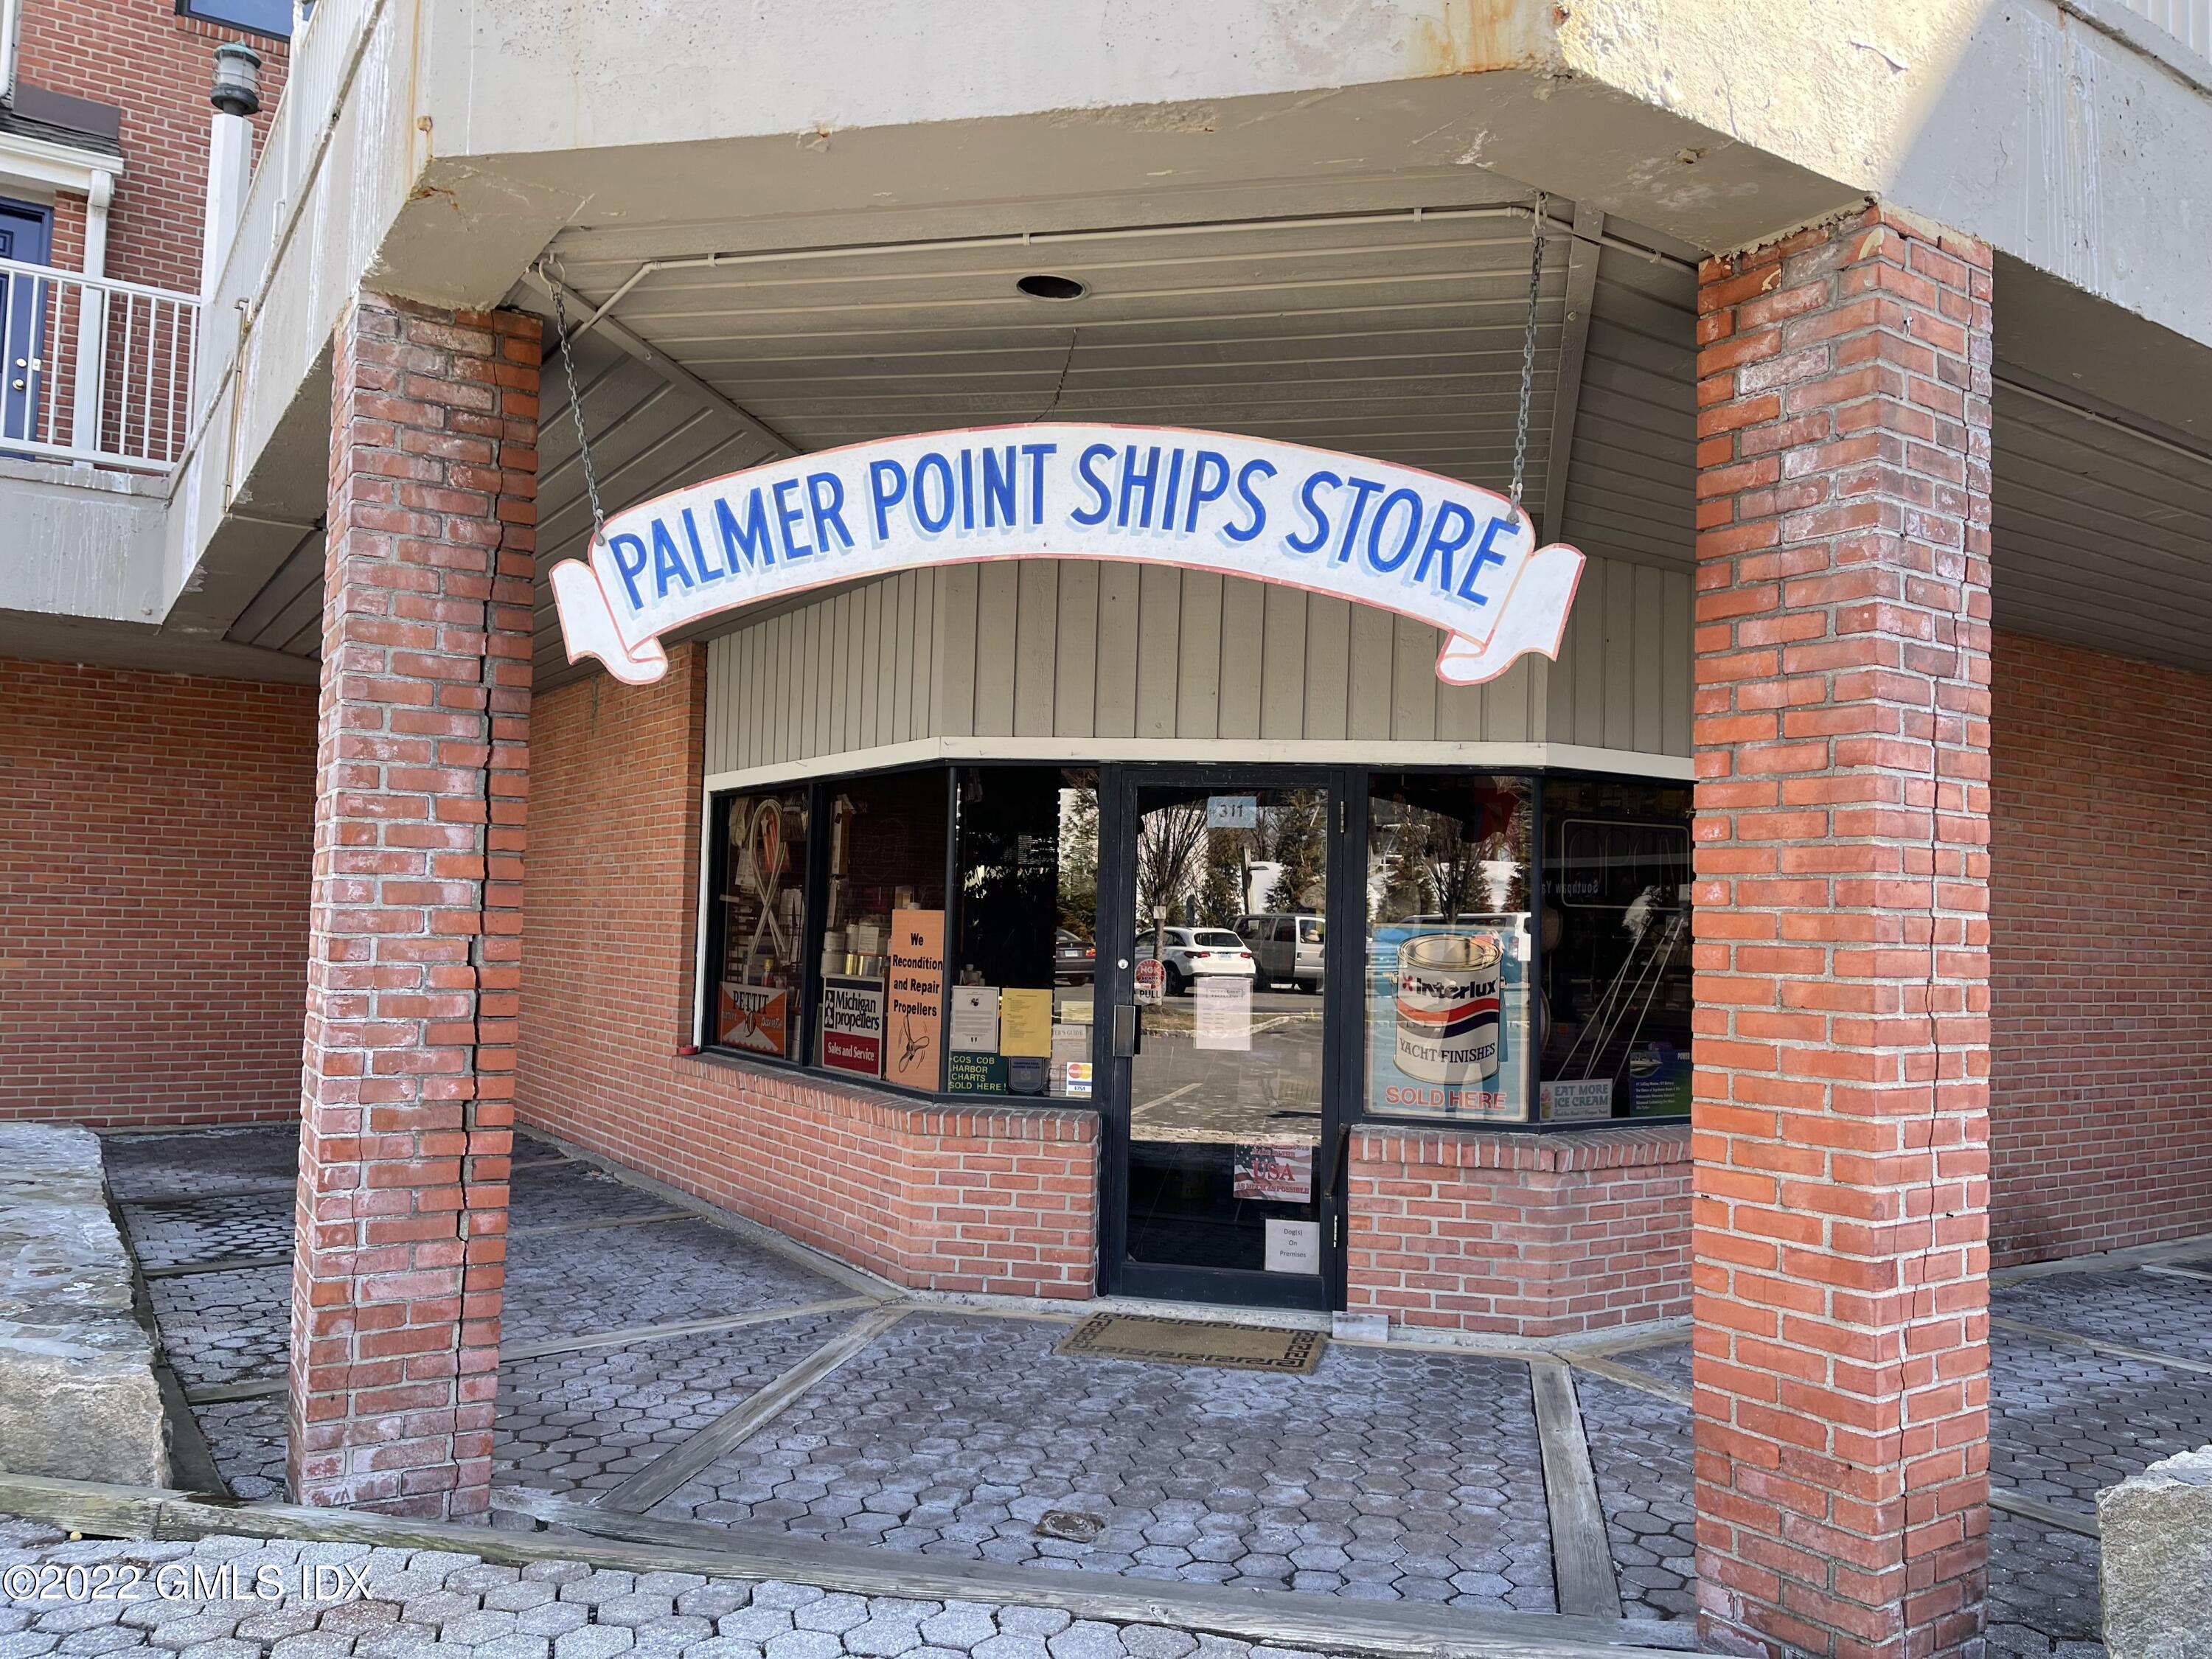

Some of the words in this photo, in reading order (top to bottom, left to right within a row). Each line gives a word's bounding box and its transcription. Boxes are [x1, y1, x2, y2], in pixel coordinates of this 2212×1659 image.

[607, 470, 855, 611] PALMER
[869, 443, 1057, 540] POINT
[1068, 442, 1279, 543] SHIPS
[1286, 470, 1522, 608] STORE
[911, 932, 924, 946] We
[893, 954, 943, 970] Recondition
[894, 978, 908, 991] and
[911, 978, 940, 995] Repair
[1139, 990, 1161, 998] PULL
[733, 990, 769, 1015] PETTIT
[835, 990, 877, 1014] Michigan
[894, 999, 937, 1017] Propellers
[835, 1011, 880, 1032] propellers
[827, 1041, 841, 1056] Sales
[842, 1045, 853, 1057] and
[853, 1047, 874, 1061] Service
[1399, 1038, 1437, 1062] YACHT
[1441, 1042, 1496, 1063] FINISHES
[951, 1073, 986, 1082] CHARTS
[953, 1065, 988, 1074] HARBOR
[949, 1082, 973, 1090] SOLD
[1554, 1085, 1575, 1096] EAT
[1579, 1084, 1609, 1096] MORE
[1386, 1085, 1445, 1107] SOLD
[1448, 1091, 1507, 1110] HERE
[1554, 1097, 1570, 1107] ICE
[1571, 1095, 1608, 1107] CREAM
[1251, 1160, 1295, 1182] USA
[1276, 1186, 1310, 1194] POSSIBLE
[1284, 1228, 1303, 1237] Dog(s)
